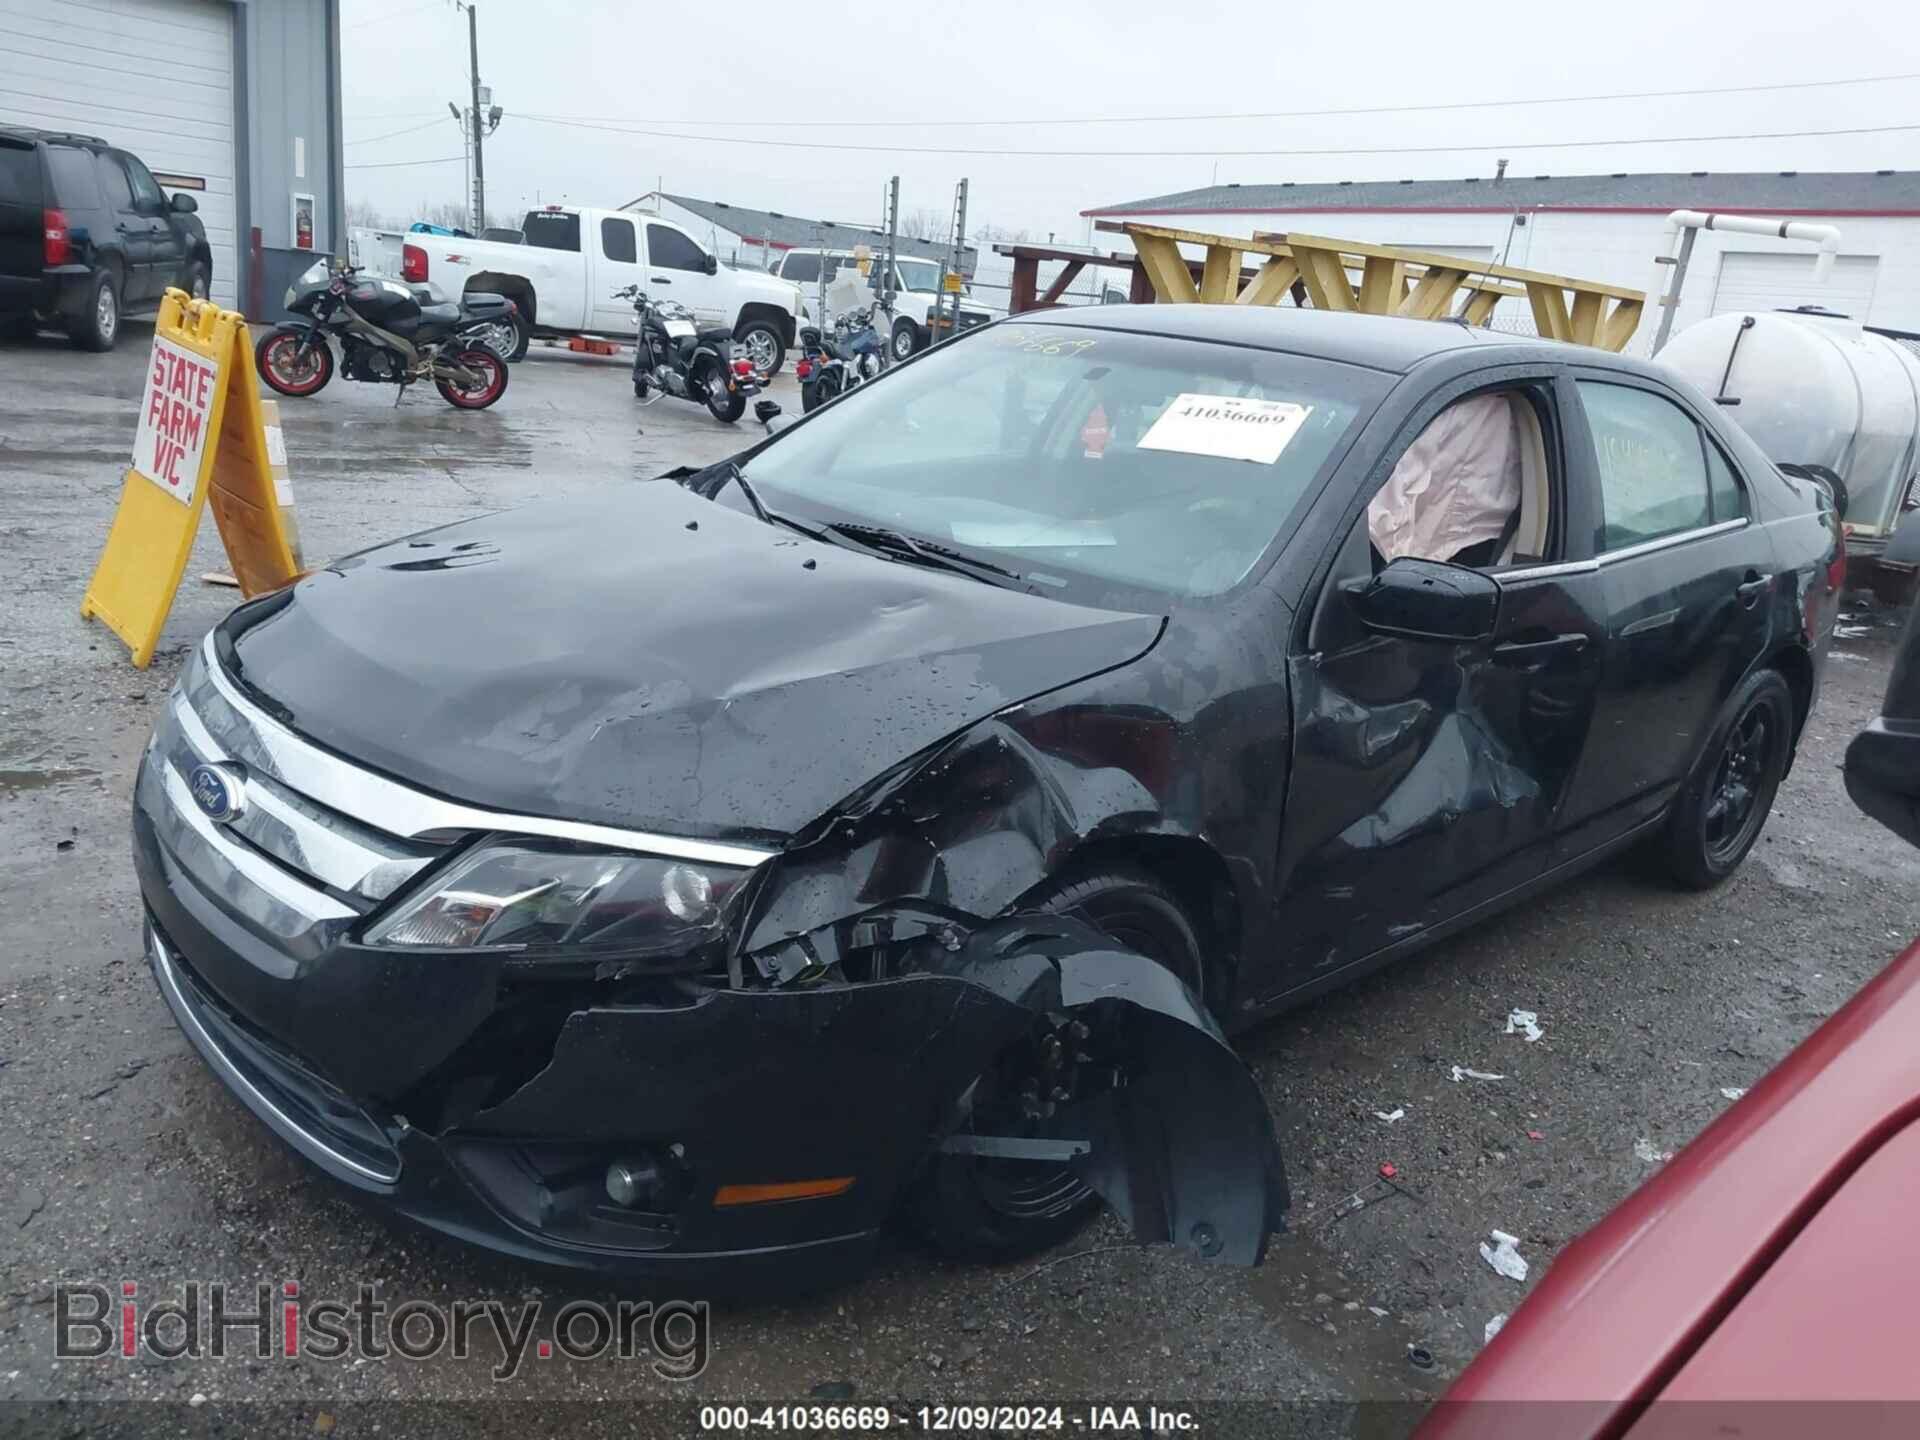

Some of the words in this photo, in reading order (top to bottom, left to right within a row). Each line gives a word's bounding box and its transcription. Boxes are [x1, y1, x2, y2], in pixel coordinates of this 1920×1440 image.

[153, 348, 212, 410] STATE
[148, 389, 202, 452] FARM
[1178, 406, 1286, 425] 41036669
[153, 434, 185, 486] VIC
[192, 771, 222, 808] Ford
